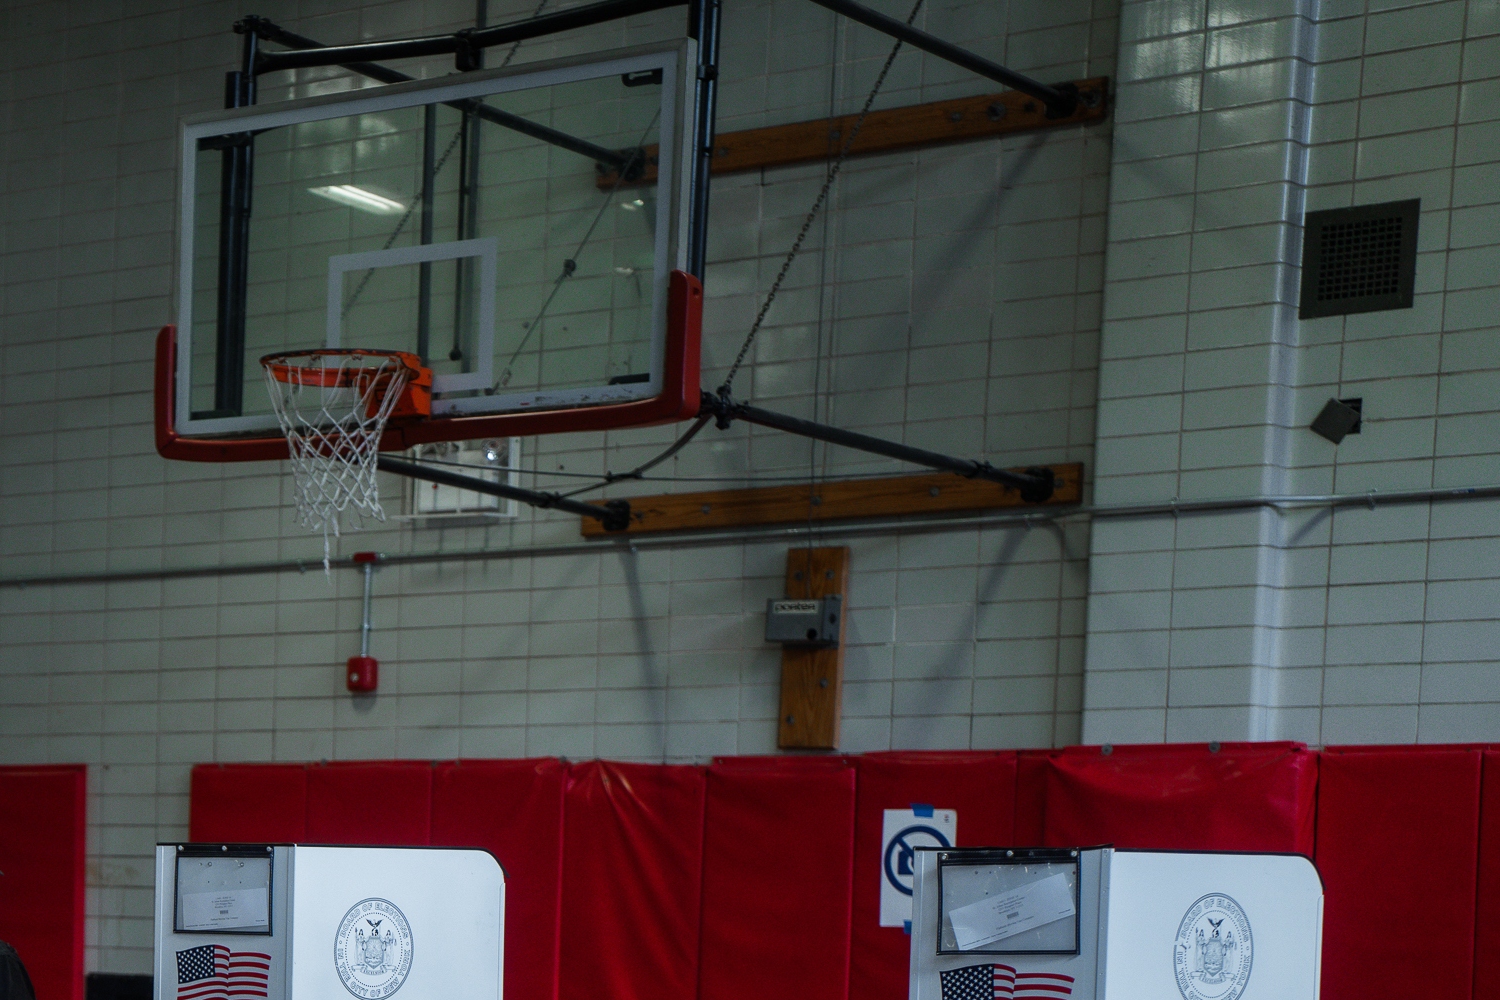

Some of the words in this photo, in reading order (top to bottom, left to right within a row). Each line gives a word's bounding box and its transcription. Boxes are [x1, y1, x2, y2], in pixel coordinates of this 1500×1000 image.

[341, 908, 360, 938] BOARD
[362, 902, 372, 912] OF
[375, 902, 409, 939] ELECTIONS
[1180, 905, 1203, 939] BOARD
[1204, 898, 1215, 909] OF
[1217, 898, 1249, 942] ELECTIONS
[337, 948, 344, 960] IN
[398, 949, 410, 977] YORK
[340, 962, 351, 983] THE
[1178, 967, 1190, 991] THE
[1236, 955, 1250, 987] YORK
[350, 981, 368, 997] CITY
[370, 989, 381, 998] OF
[383, 977, 399, 994] NEW
